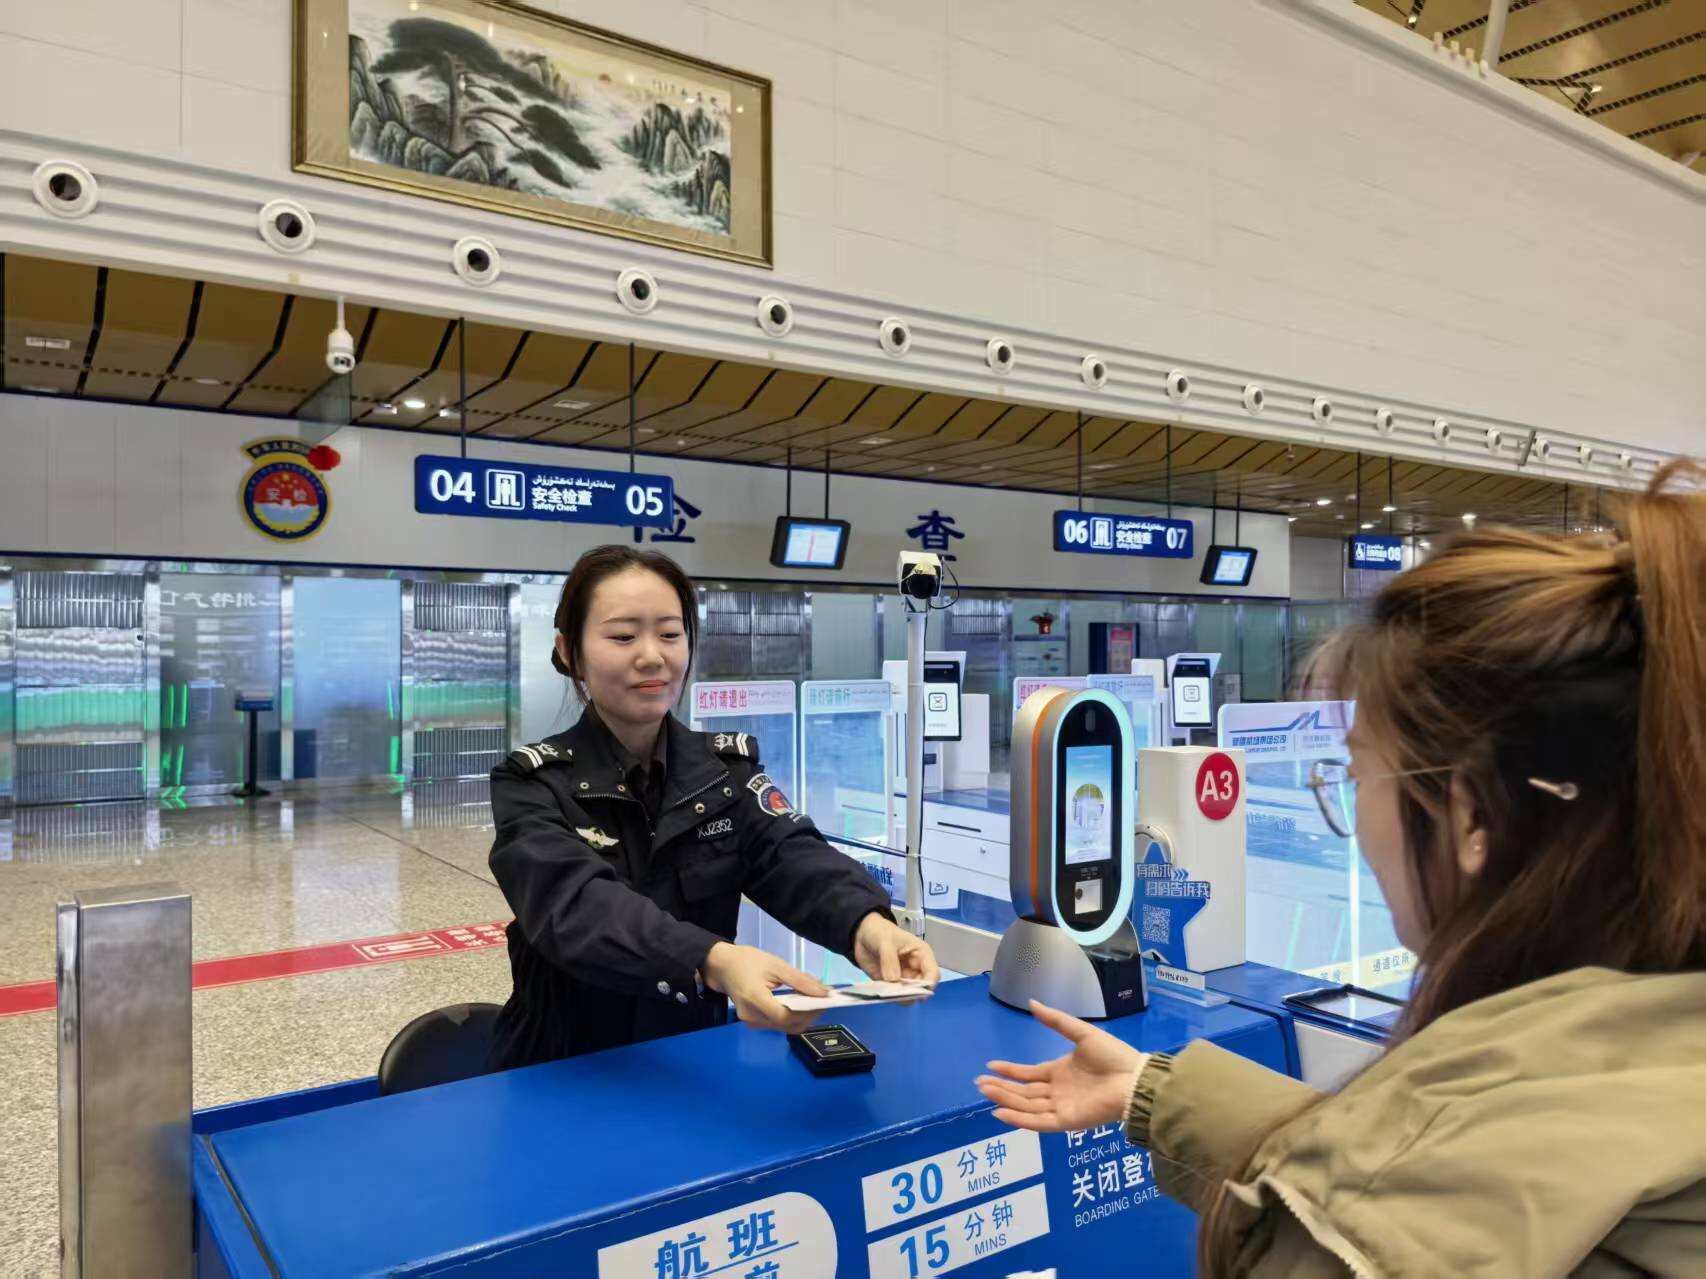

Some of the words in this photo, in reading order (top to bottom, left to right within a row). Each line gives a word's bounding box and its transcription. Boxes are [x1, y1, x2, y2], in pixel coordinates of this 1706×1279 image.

[430, 470, 475, 504] 04
[532, 486, 592, 506] 安全检查
[626, 485, 664, 517] 05
[1064, 519, 1088, 544] 06
[1166, 527, 1187, 549] 07
[699, 687, 747, 709] 红灯请退出
[1201, 770, 1232, 802] A3
[697, 818, 733, 838] XJ2352
[1068, 1141, 1120, 1168] CHECK-IN
[892, 1163, 943, 1214] 30
[957, 1139, 1007, 1178] 分钟
[967, 1172, 1000, 1192] MINS
[1075, 1197, 1130, 1228] BOARDING
[1134, 1185, 1160, 1205] GATE
[655, 1209, 778, 1279] 航班
[900, 1225, 950, 1277] 15
[964, 1201, 1013, 1241] 分钟
[974, 1234, 1007, 1256] MINS
